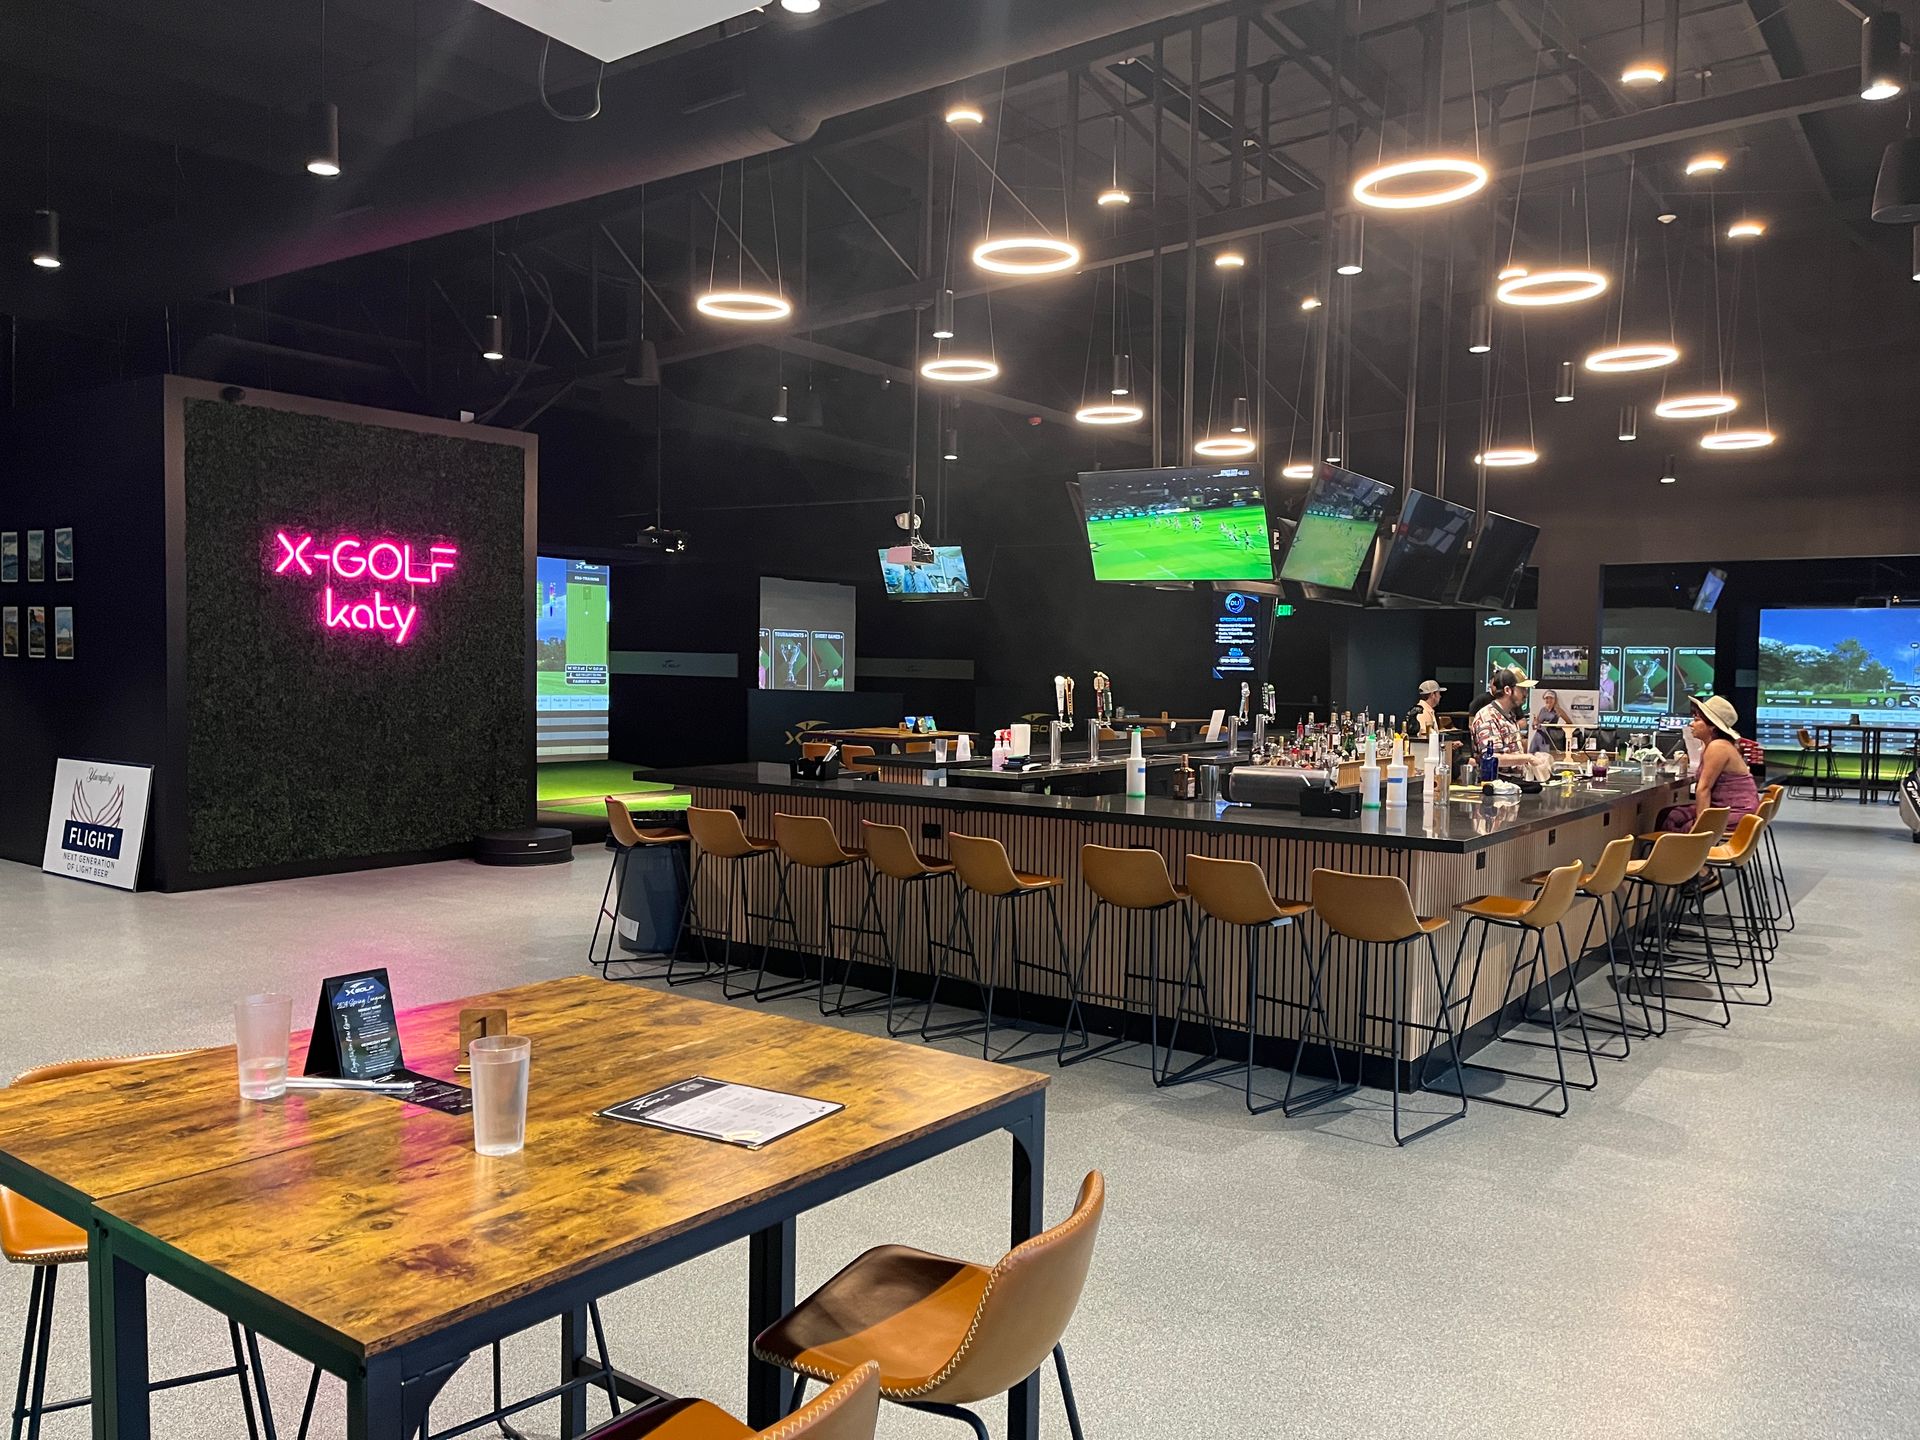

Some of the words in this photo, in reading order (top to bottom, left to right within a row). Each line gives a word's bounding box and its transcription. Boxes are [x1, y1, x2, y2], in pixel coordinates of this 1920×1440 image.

[275, 532, 457, 583] X-GOLF
[326, 587, 416, 644] katy
[1278, 604, 1291, 616] EXIT
[1603, 715, 1621, 723] WIN
[1621, 715, 1639, 724] FUN
[69, 827, 115, 851] FLIGHT
[63, 852, 79, 861] NEXT
[78, 855, 116, 869] GENERATION
[66, 862, 75, 871] OF
[75, 864, 93, 874] LIGHT
[93, 867, 109, 878] BEER
[474, 1016, 487, 1039] 1
